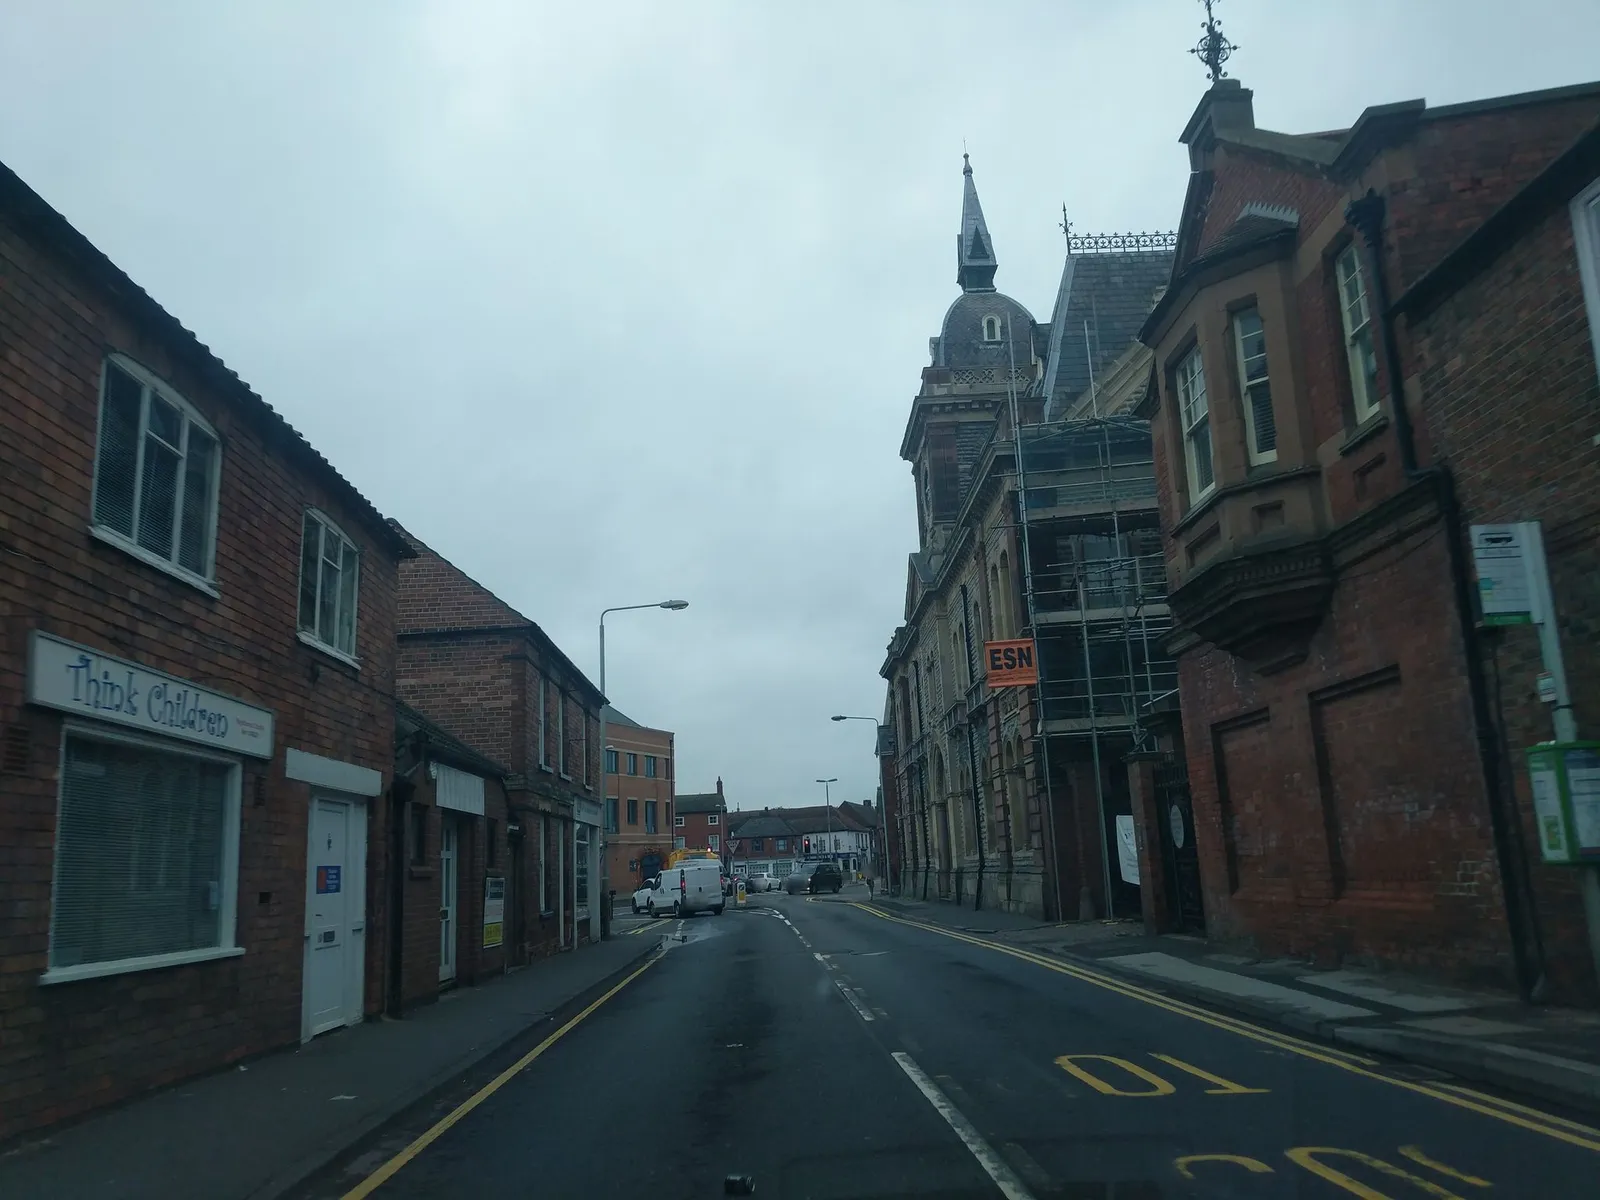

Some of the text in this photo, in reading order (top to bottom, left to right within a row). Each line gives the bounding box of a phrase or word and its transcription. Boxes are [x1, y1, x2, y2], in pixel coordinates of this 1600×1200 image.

[989, 646, 1033, 671] ESN
[65, 654, 229, 739] Think Children
